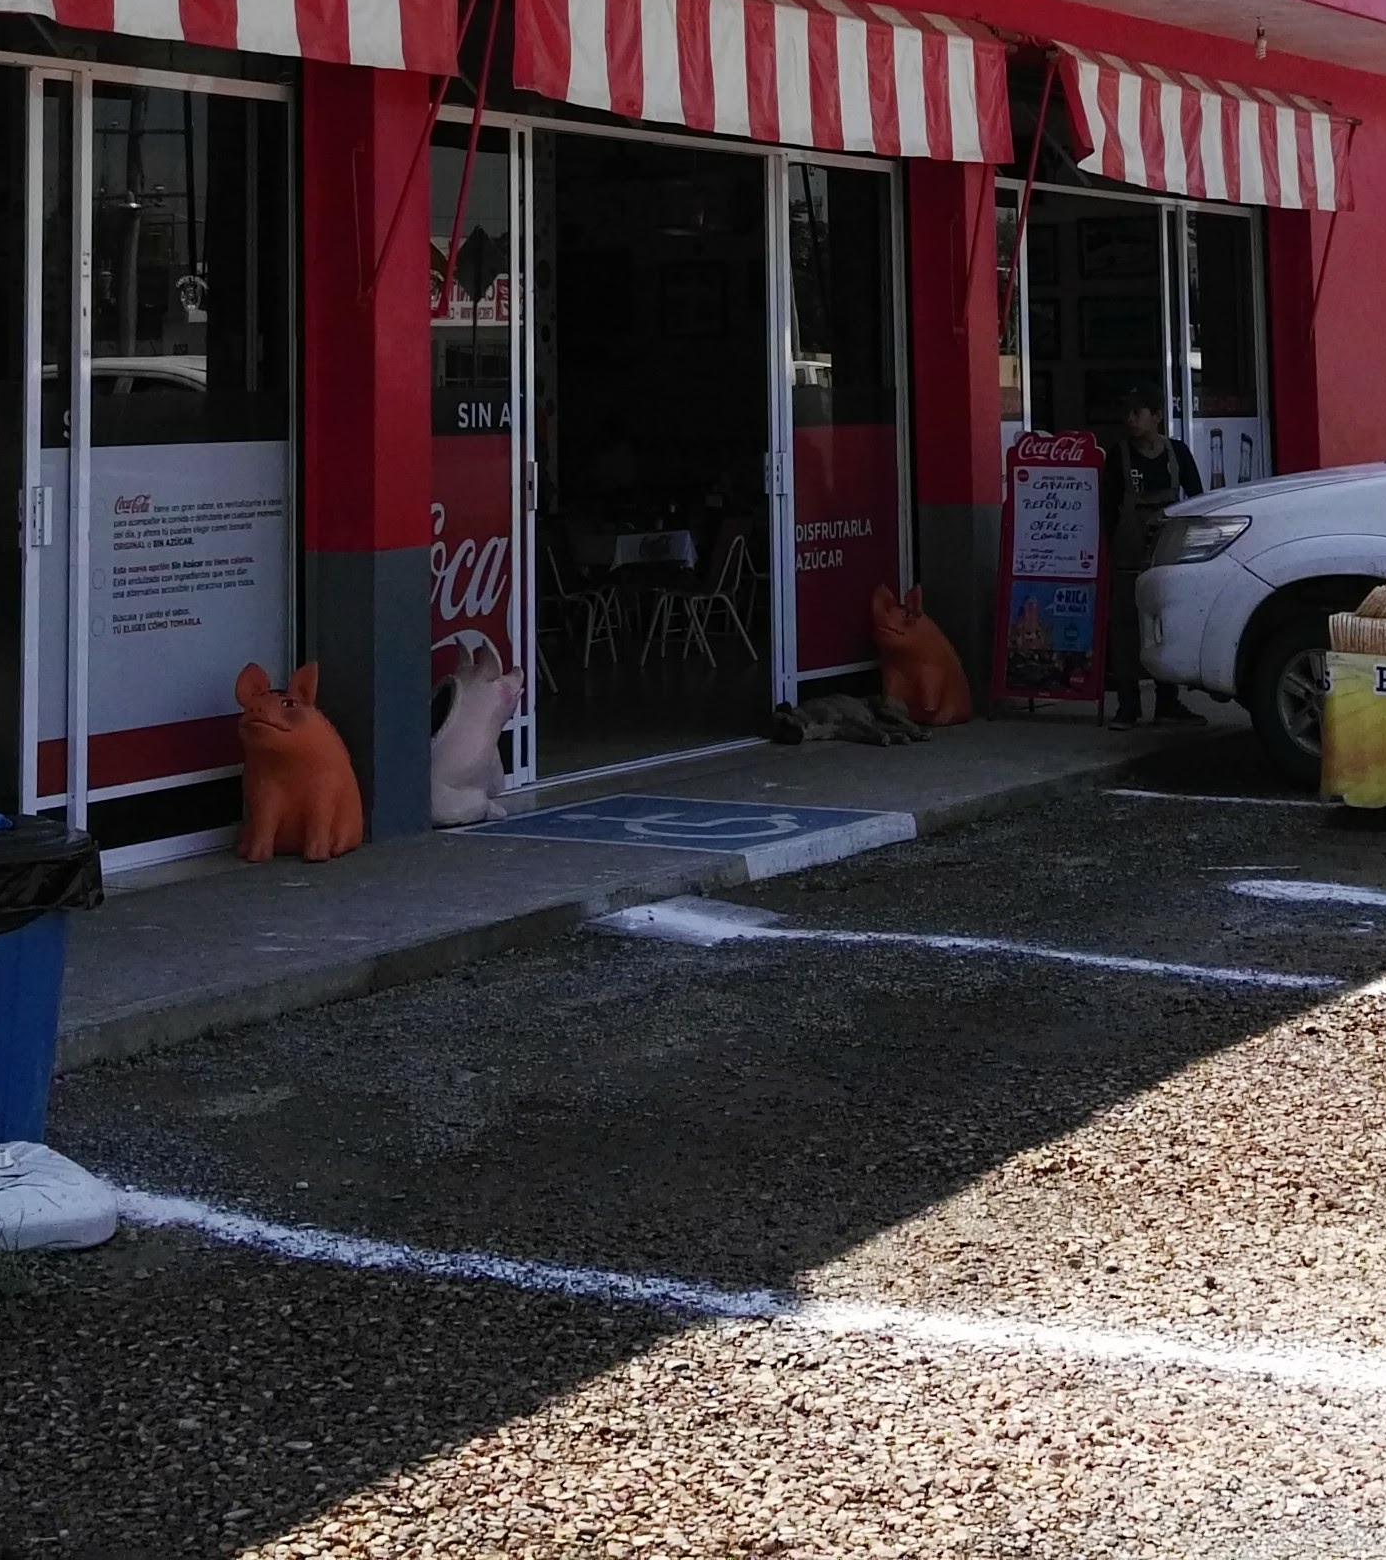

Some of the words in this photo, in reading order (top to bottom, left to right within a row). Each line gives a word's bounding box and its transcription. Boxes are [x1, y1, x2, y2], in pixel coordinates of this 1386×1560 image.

[457, 402, 492, 429] SIN
[1018, 435, 1087, 462] Coca-Cola
[795, 518, 873, 543] DISFRUTARLA
